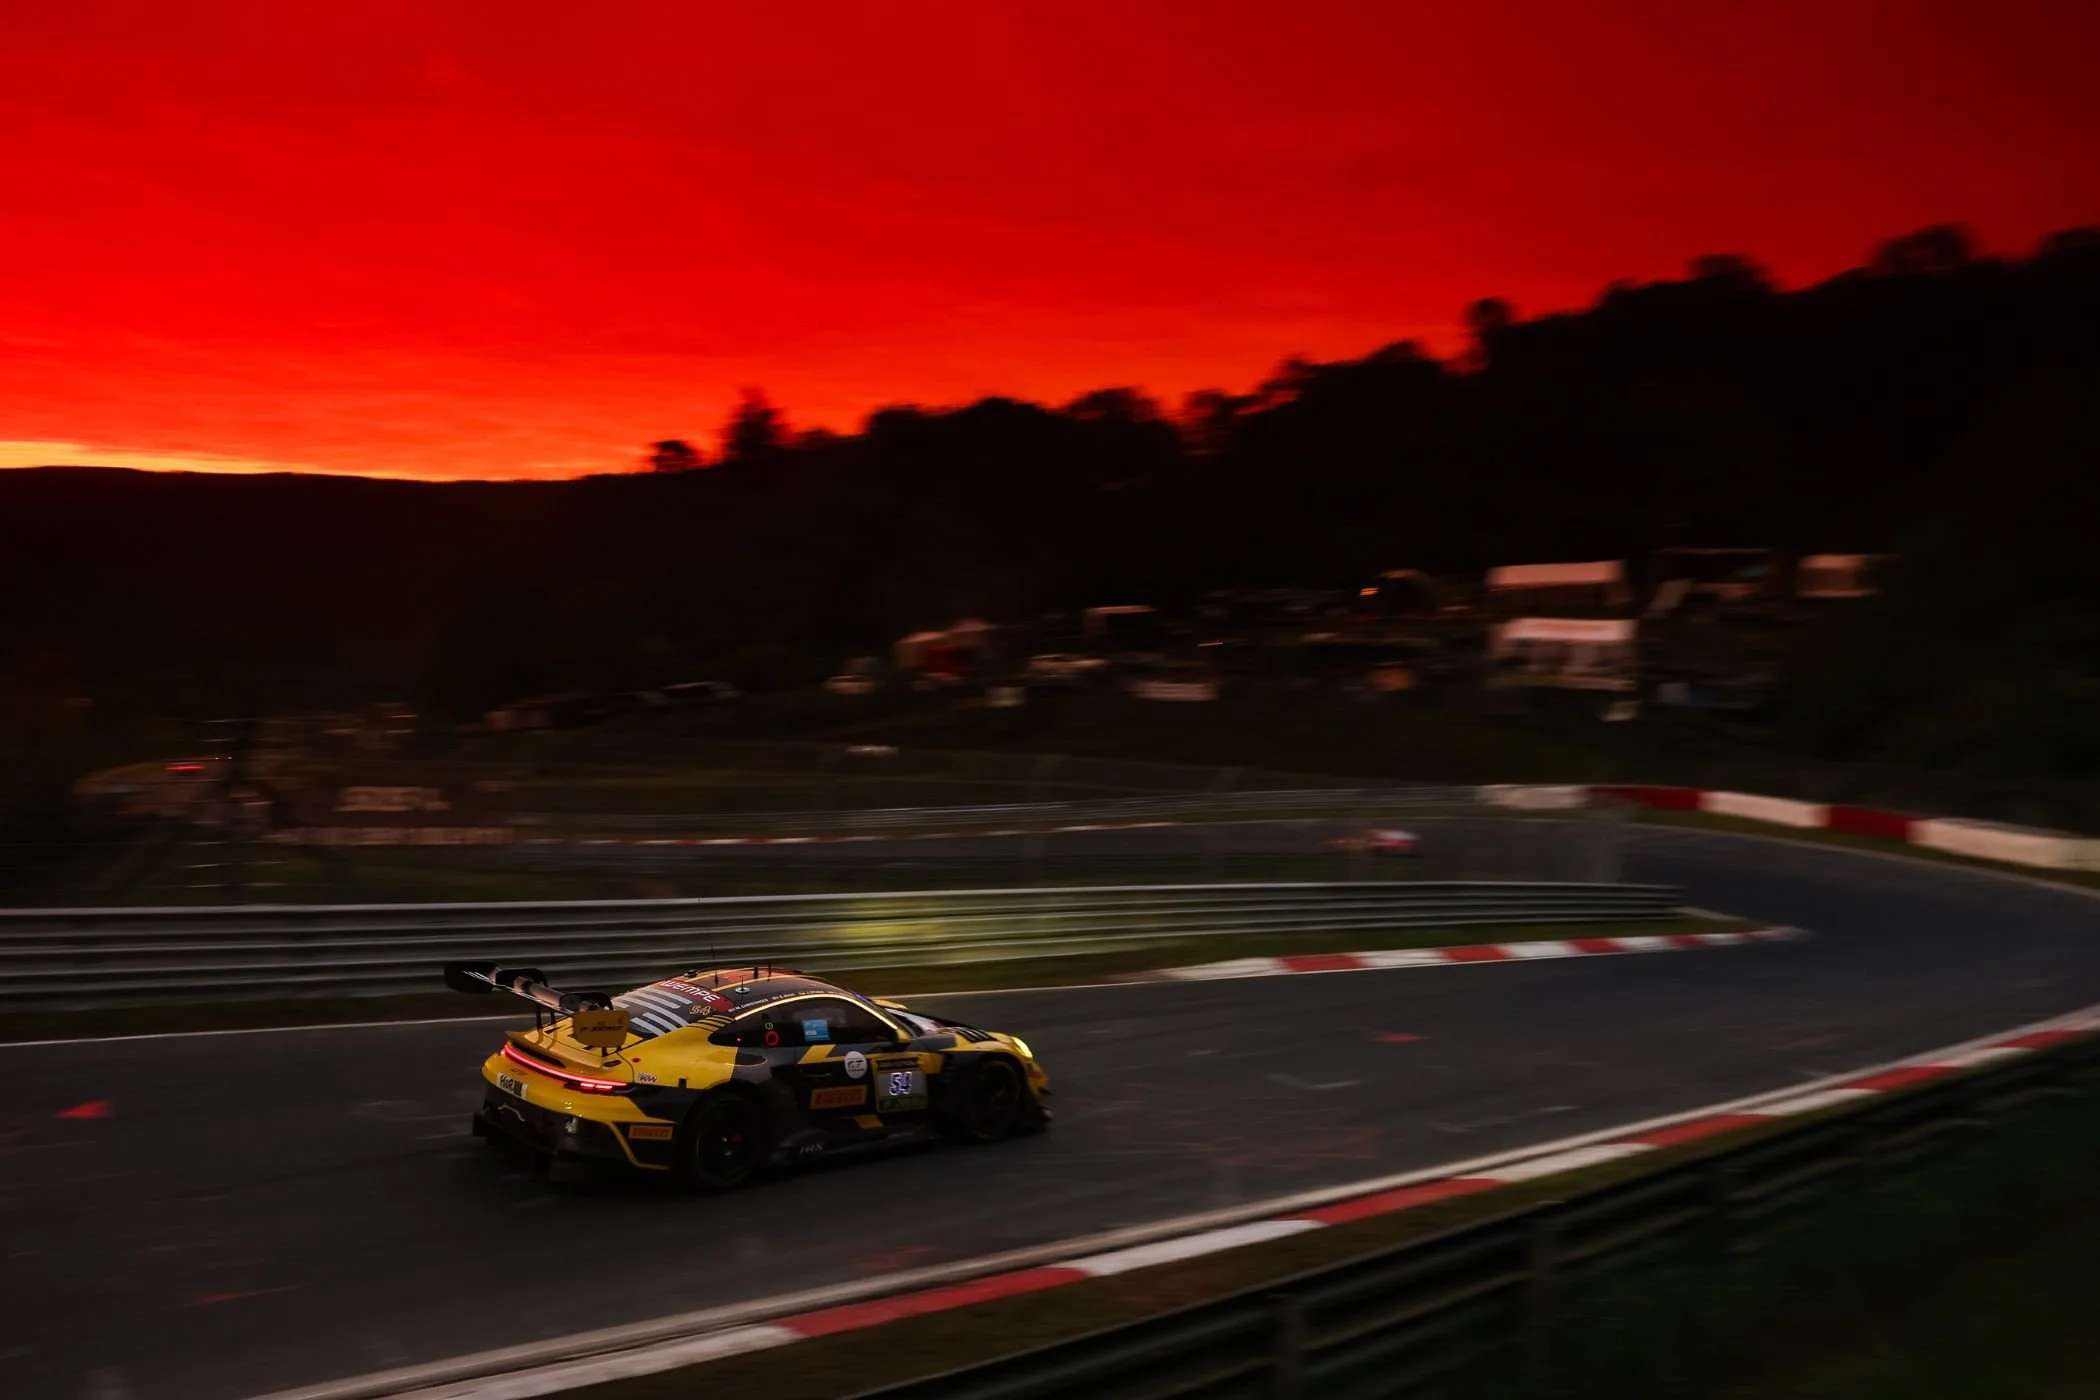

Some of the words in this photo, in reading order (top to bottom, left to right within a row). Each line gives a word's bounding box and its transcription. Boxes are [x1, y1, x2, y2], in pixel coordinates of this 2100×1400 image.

[660, 980, 720, 1003] WEMPE
[689, 1004, 712, 1016] 54
[889, 1071, 913, 1096] 54
